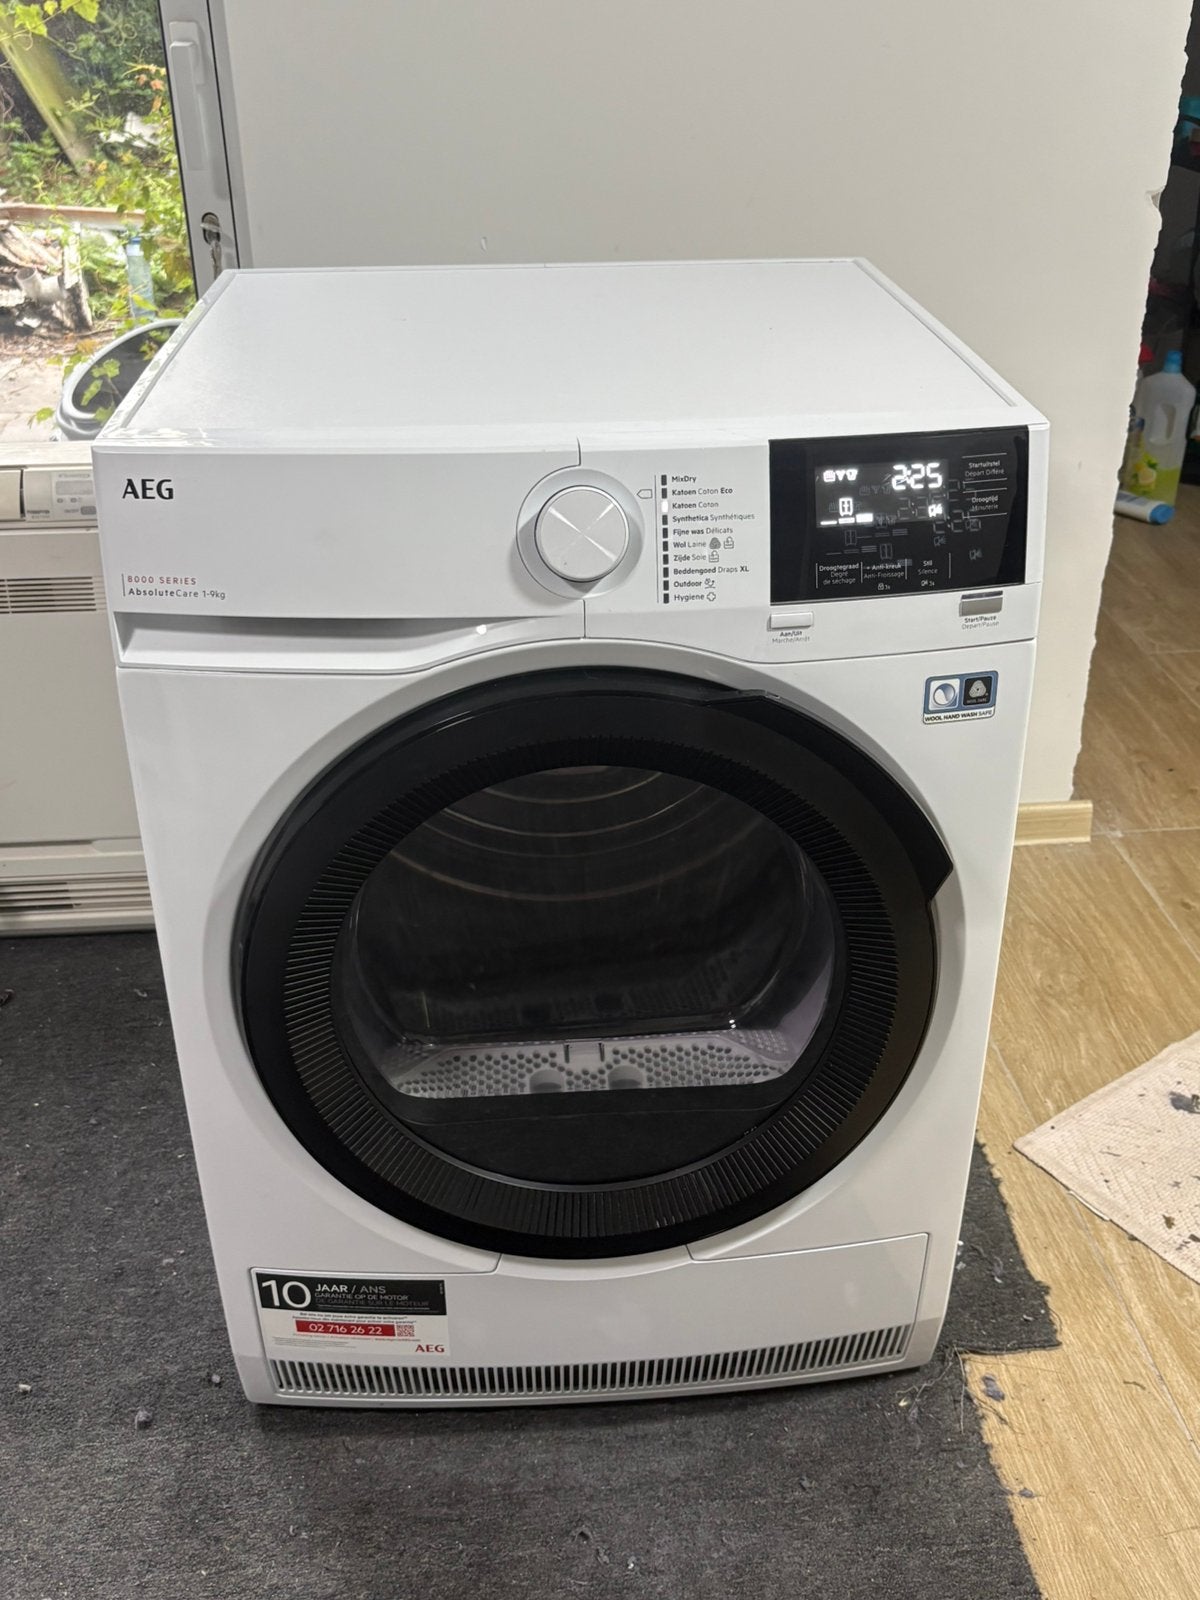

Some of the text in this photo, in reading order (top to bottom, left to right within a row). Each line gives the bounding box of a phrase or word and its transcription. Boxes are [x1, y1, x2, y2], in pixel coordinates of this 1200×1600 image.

[671, 475, 697, 483] MixDry
[891, 462, 943, 491] 2:25
[121, 478, 174, 500] AEG
[697, 487, 719, 495] Coton
[672, 515, 709, 523] Synthetica
[691, 553, 707, 561] Soie
[673, 567, 717, 575] Beddengoed
[127, 575, 197, 586] 8000 SERIES
[673, 580, 702, 588] Outdoor
[128, 588, 226, 600] AbsoluteCare 1-9kg
[261, 1279, 312, 1309] 10
[315, 1283, 348, 1293] JAAR
[359, 1285, 387, 1294] ANS
[309, 1323, 383, 1335] 02 716 26 22
[415, 1344, 445, 1353] AEG
